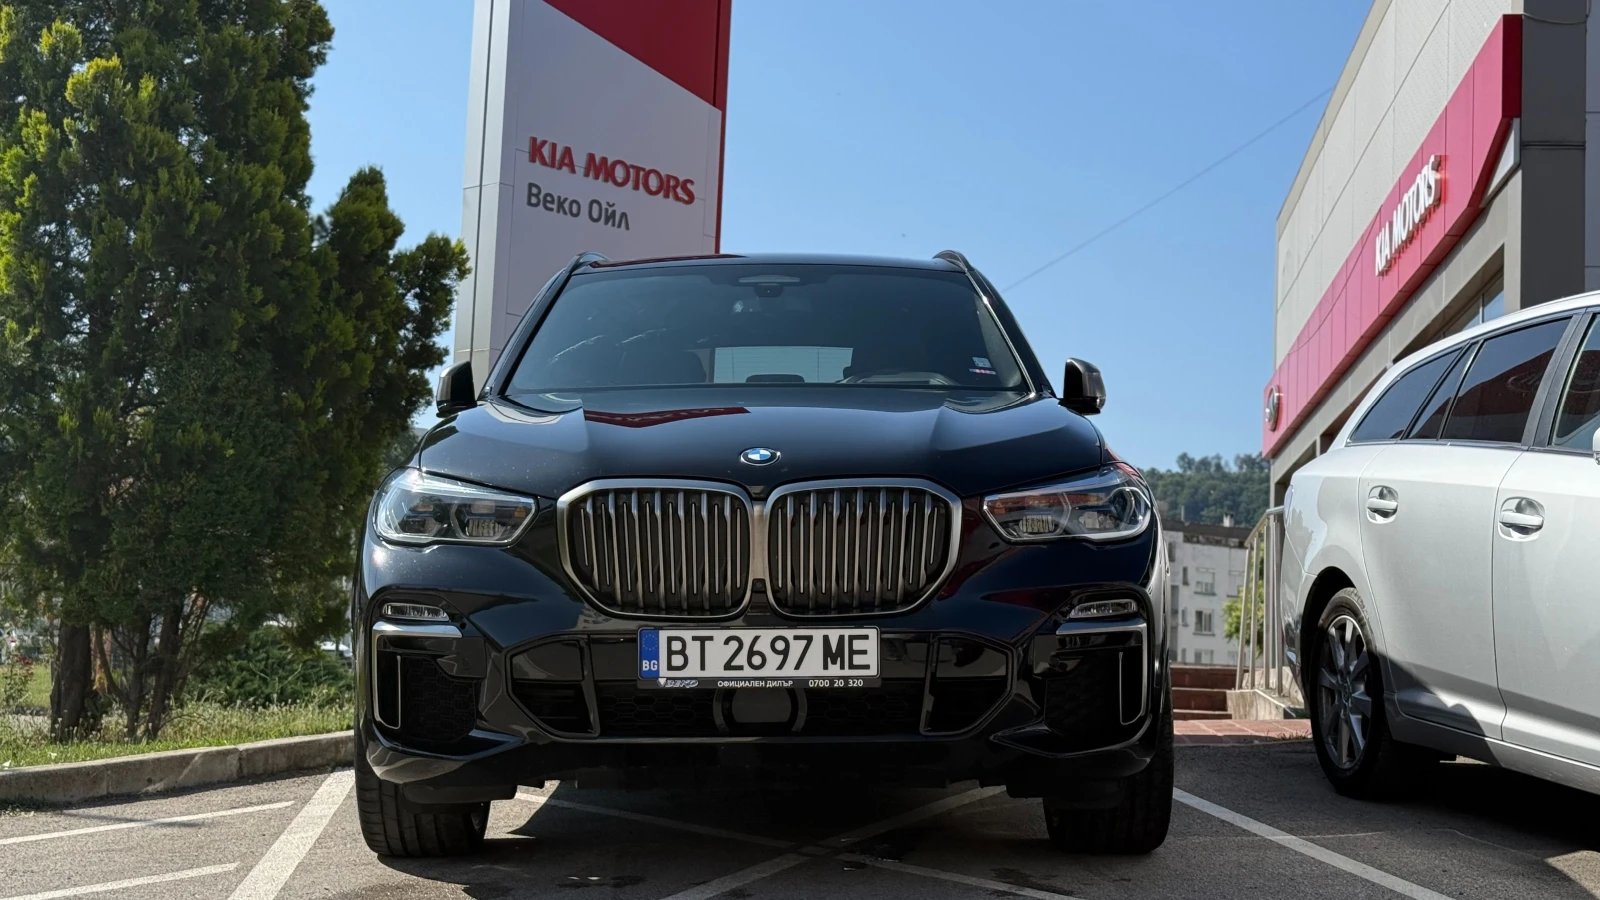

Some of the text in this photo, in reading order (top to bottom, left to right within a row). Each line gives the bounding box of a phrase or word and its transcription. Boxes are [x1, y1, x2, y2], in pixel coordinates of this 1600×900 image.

[529, 136, 695, 205] KIA MOTORS
[526, 182, 630, 230] Веко Ойл
[1375, 154, 1439, 277] KIA MOTORS
[642, 660, 658, 671] BG
[666, 634, 871, 671] BT 2697 ME
[766, 680, 793, 688] ДИЛЪР
[808, 679, 864, 687] 0700 20 320
